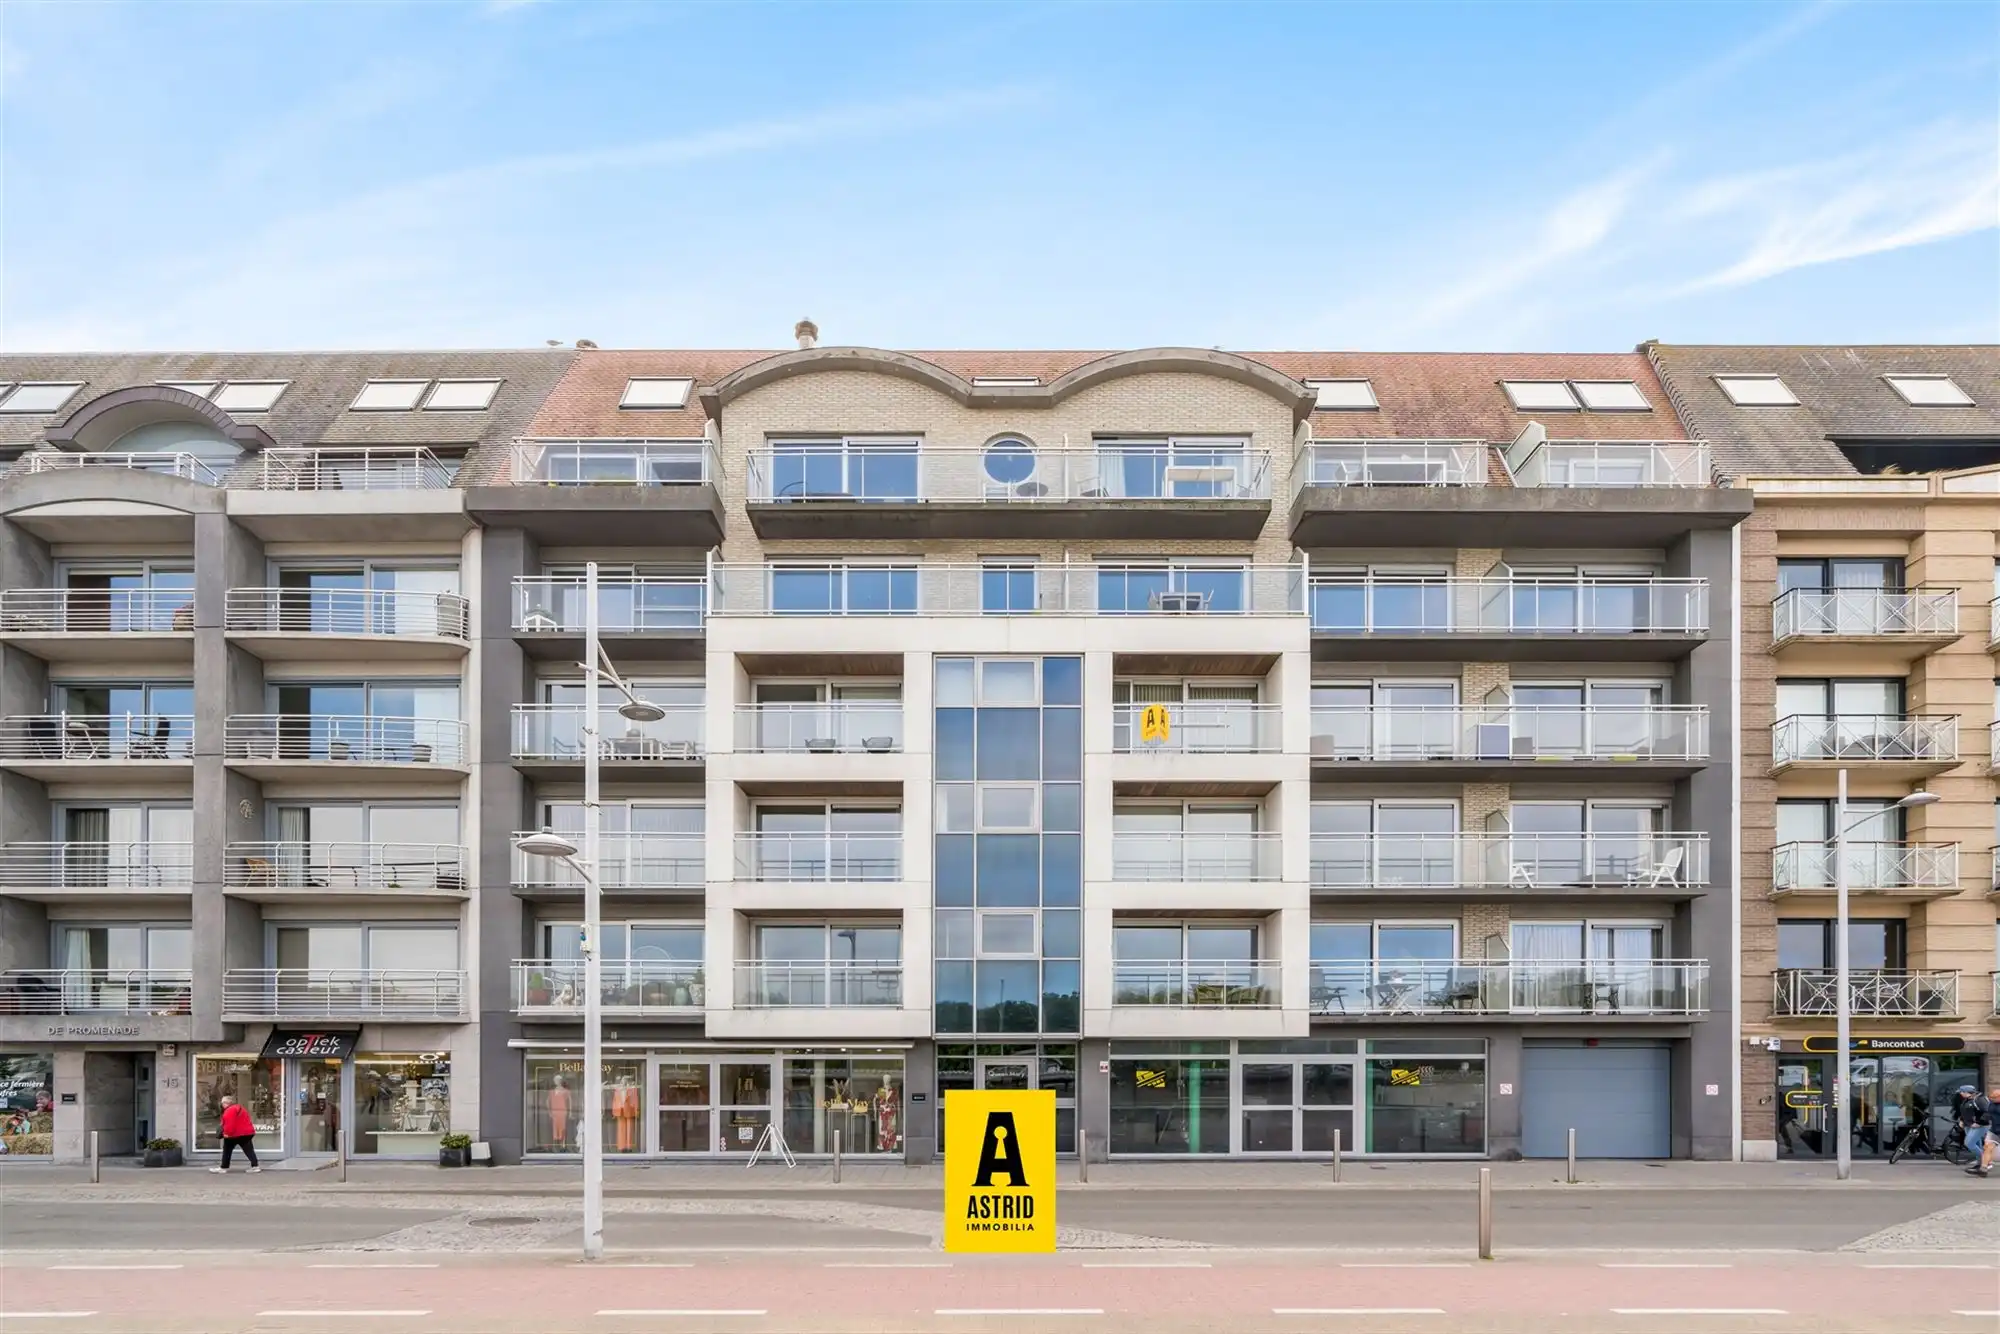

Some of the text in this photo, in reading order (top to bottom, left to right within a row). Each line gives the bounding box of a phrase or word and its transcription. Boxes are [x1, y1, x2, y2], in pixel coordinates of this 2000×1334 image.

[1147, 708, 1155, 728] A
[48, 1026, 140, 1036] DE PROMENADE
[1871, 1040, 1925, 1048] Bancontact
[9, 1080, 45, 1089] fermière
